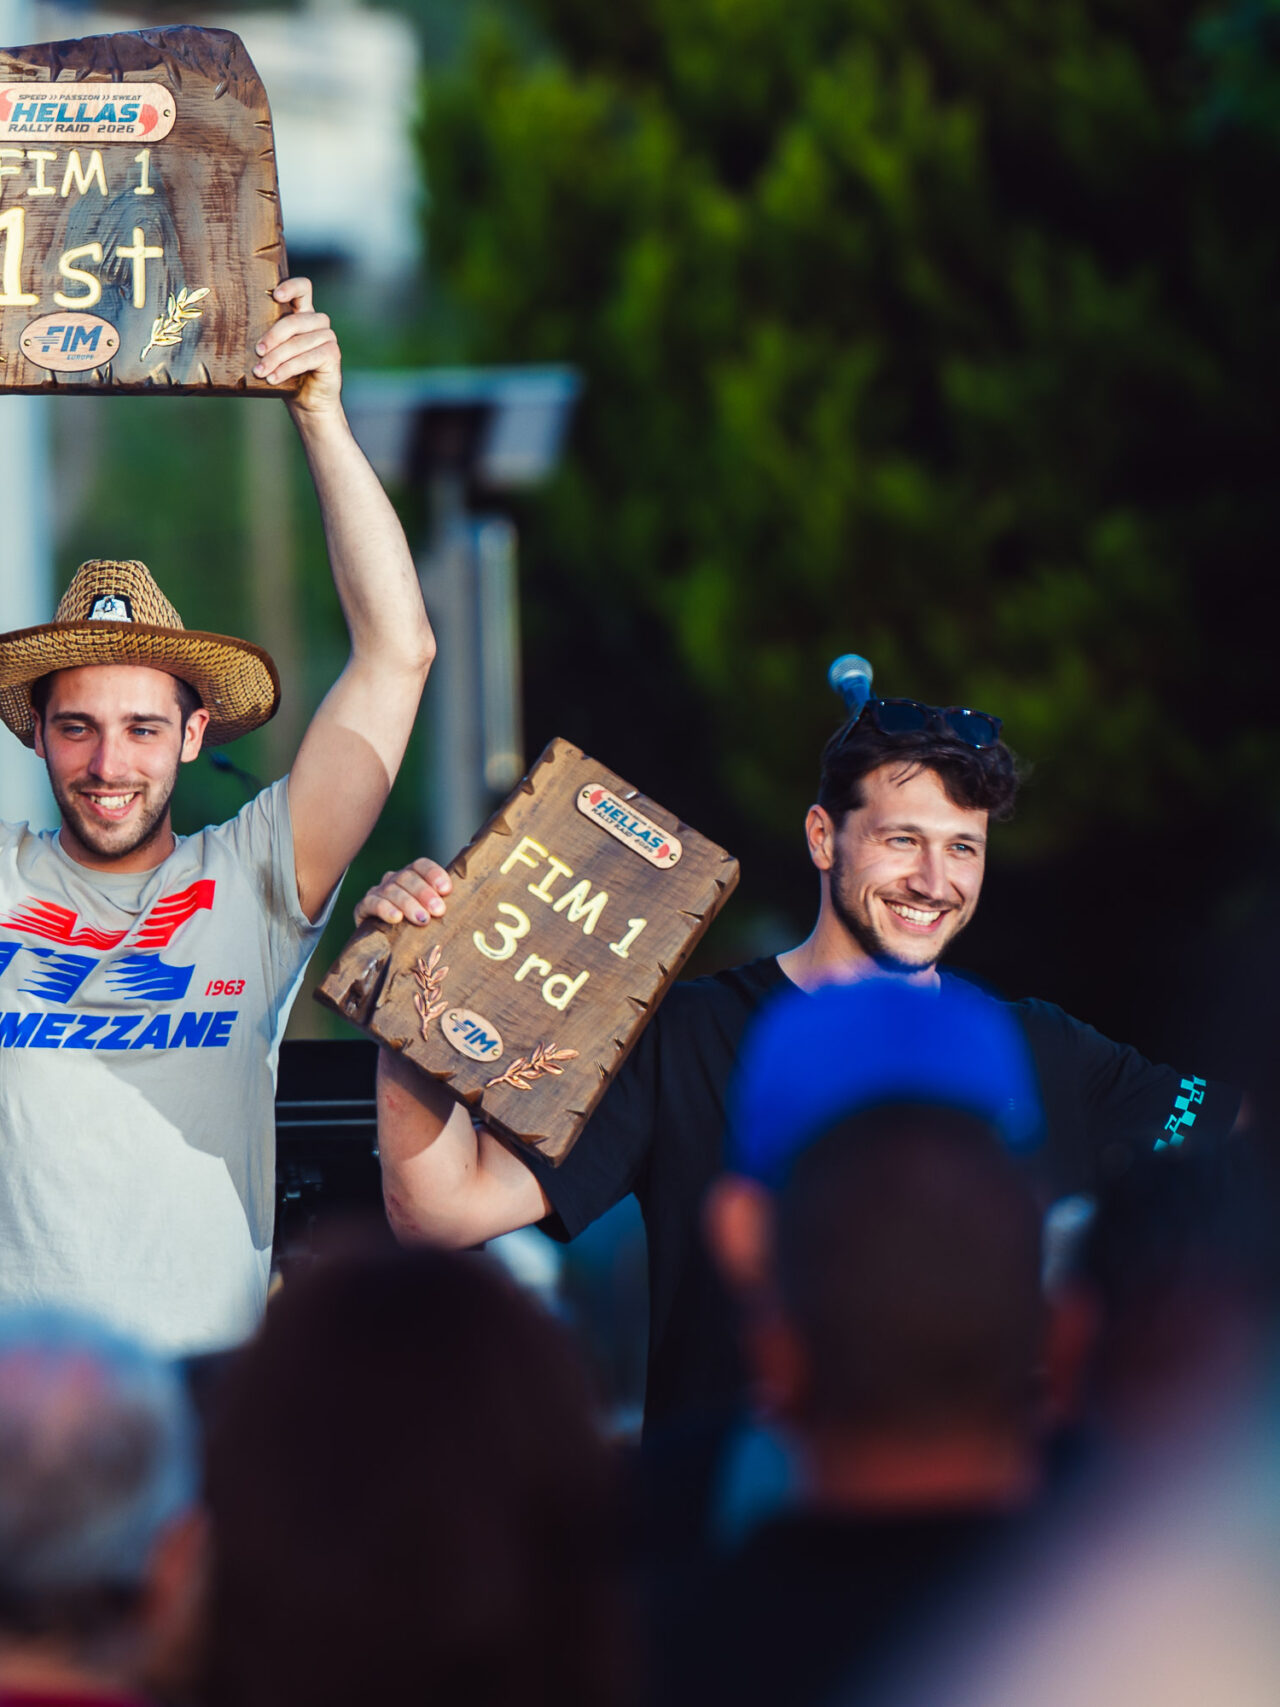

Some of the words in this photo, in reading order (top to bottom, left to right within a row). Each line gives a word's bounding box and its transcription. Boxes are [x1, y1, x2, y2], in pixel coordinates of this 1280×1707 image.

[8, 124, 52, 133] RALLY
[55, 124, 90, 133] RAID
[97, 124, 135, 133] 2026
[11, 102, 140, 123] HELLAS
[133, 148, 155, 196] 1
[33, 325, 104, 352] FIM
[596, 800, 664, 848] HELLAS
[498, 835, 609, 936] FIM
[608, 917, 648, 959] 1
[472, 901, 590, 1011] 3rd
[204, 979, 247, 997] 1963
[452, 1019, 498, 1053] FIM
